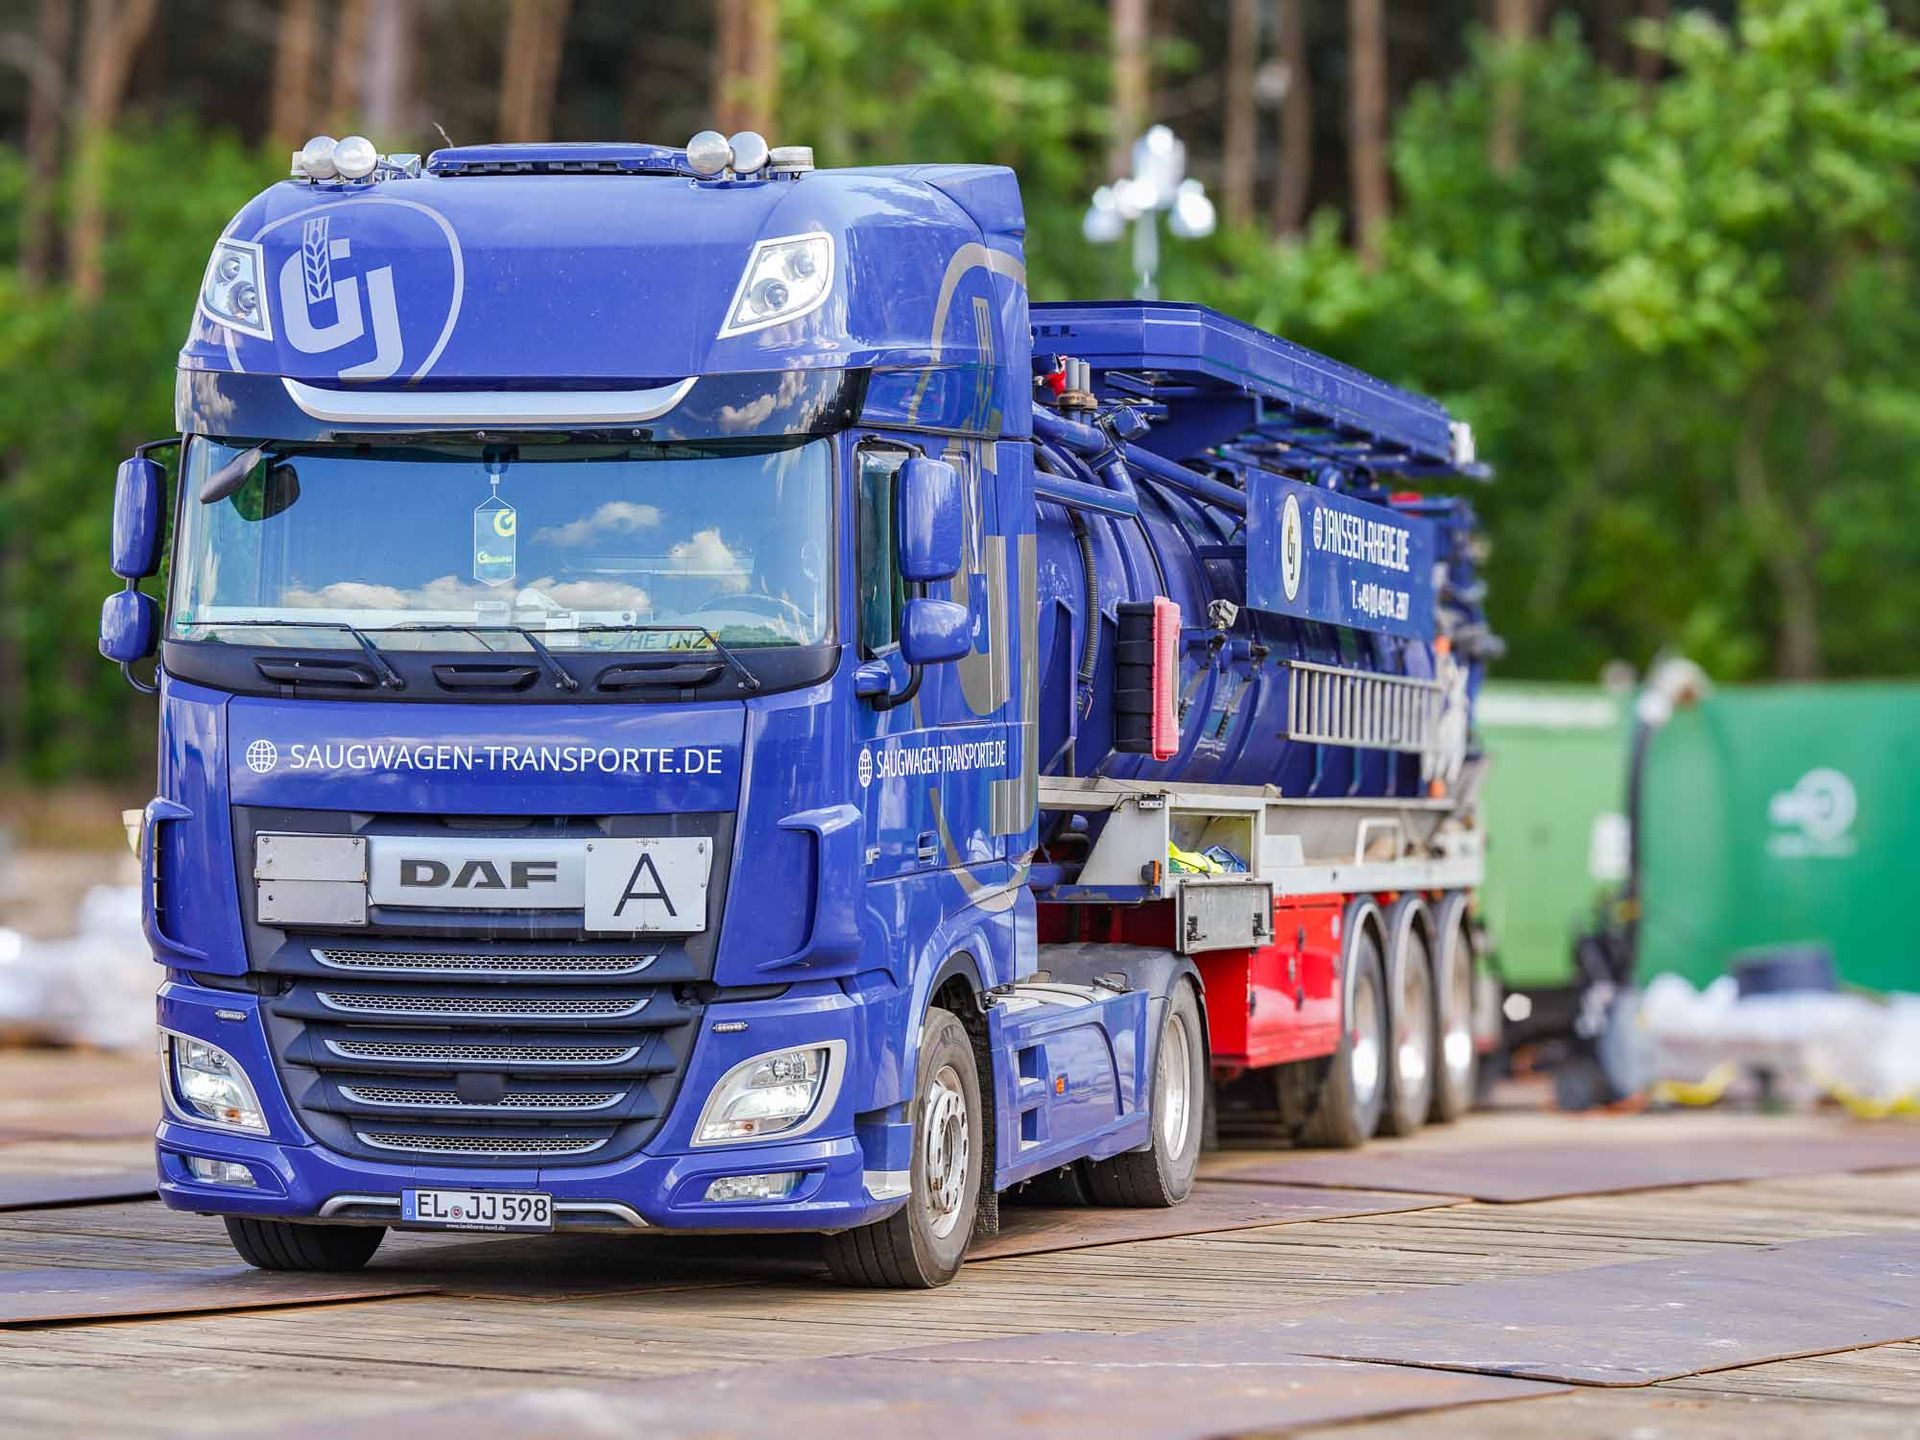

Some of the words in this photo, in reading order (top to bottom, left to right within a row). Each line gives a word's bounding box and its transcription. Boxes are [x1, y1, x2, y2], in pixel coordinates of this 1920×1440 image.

[290, 744, 722, 774] SAUGWAGEN-TRANSPORTE.DE
[876, 740, 1006, 779] SAUGWAGEN-TRANSPORTE.DE
[400, 858, 558, 890] DAF
[613, 852, 678, 918] A
[417, 1193, 448, 1218] EL
